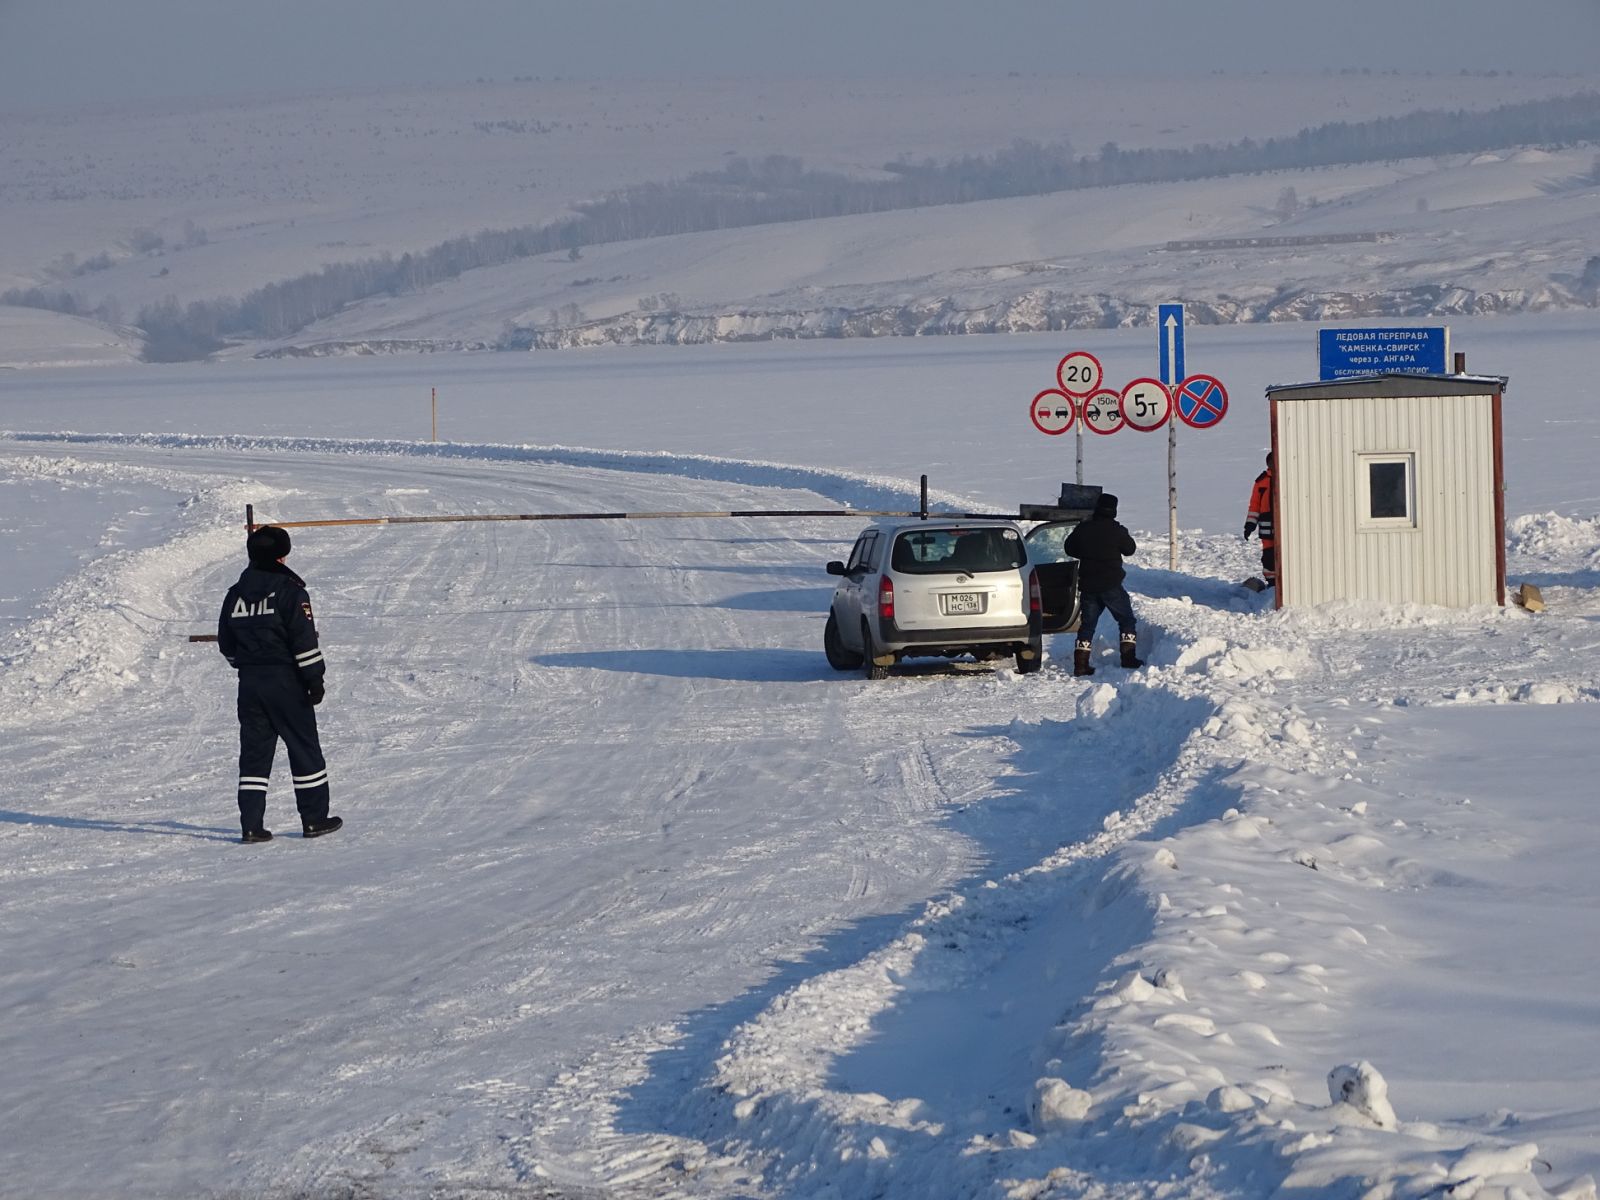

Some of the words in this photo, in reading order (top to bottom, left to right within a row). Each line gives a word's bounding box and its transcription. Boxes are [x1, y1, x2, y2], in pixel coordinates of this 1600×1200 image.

[1336, 333, 1376, 341] ЛЕДОВАЯ
[1378, 332, 1429, 340] ПЕРЕПРАВА
[1349, 356, 1372, 364] через
[1067, 366, 1092, 383] 20
[1097, 397, 1117, 405] 150м
[959, 594, 974, 602] 026
